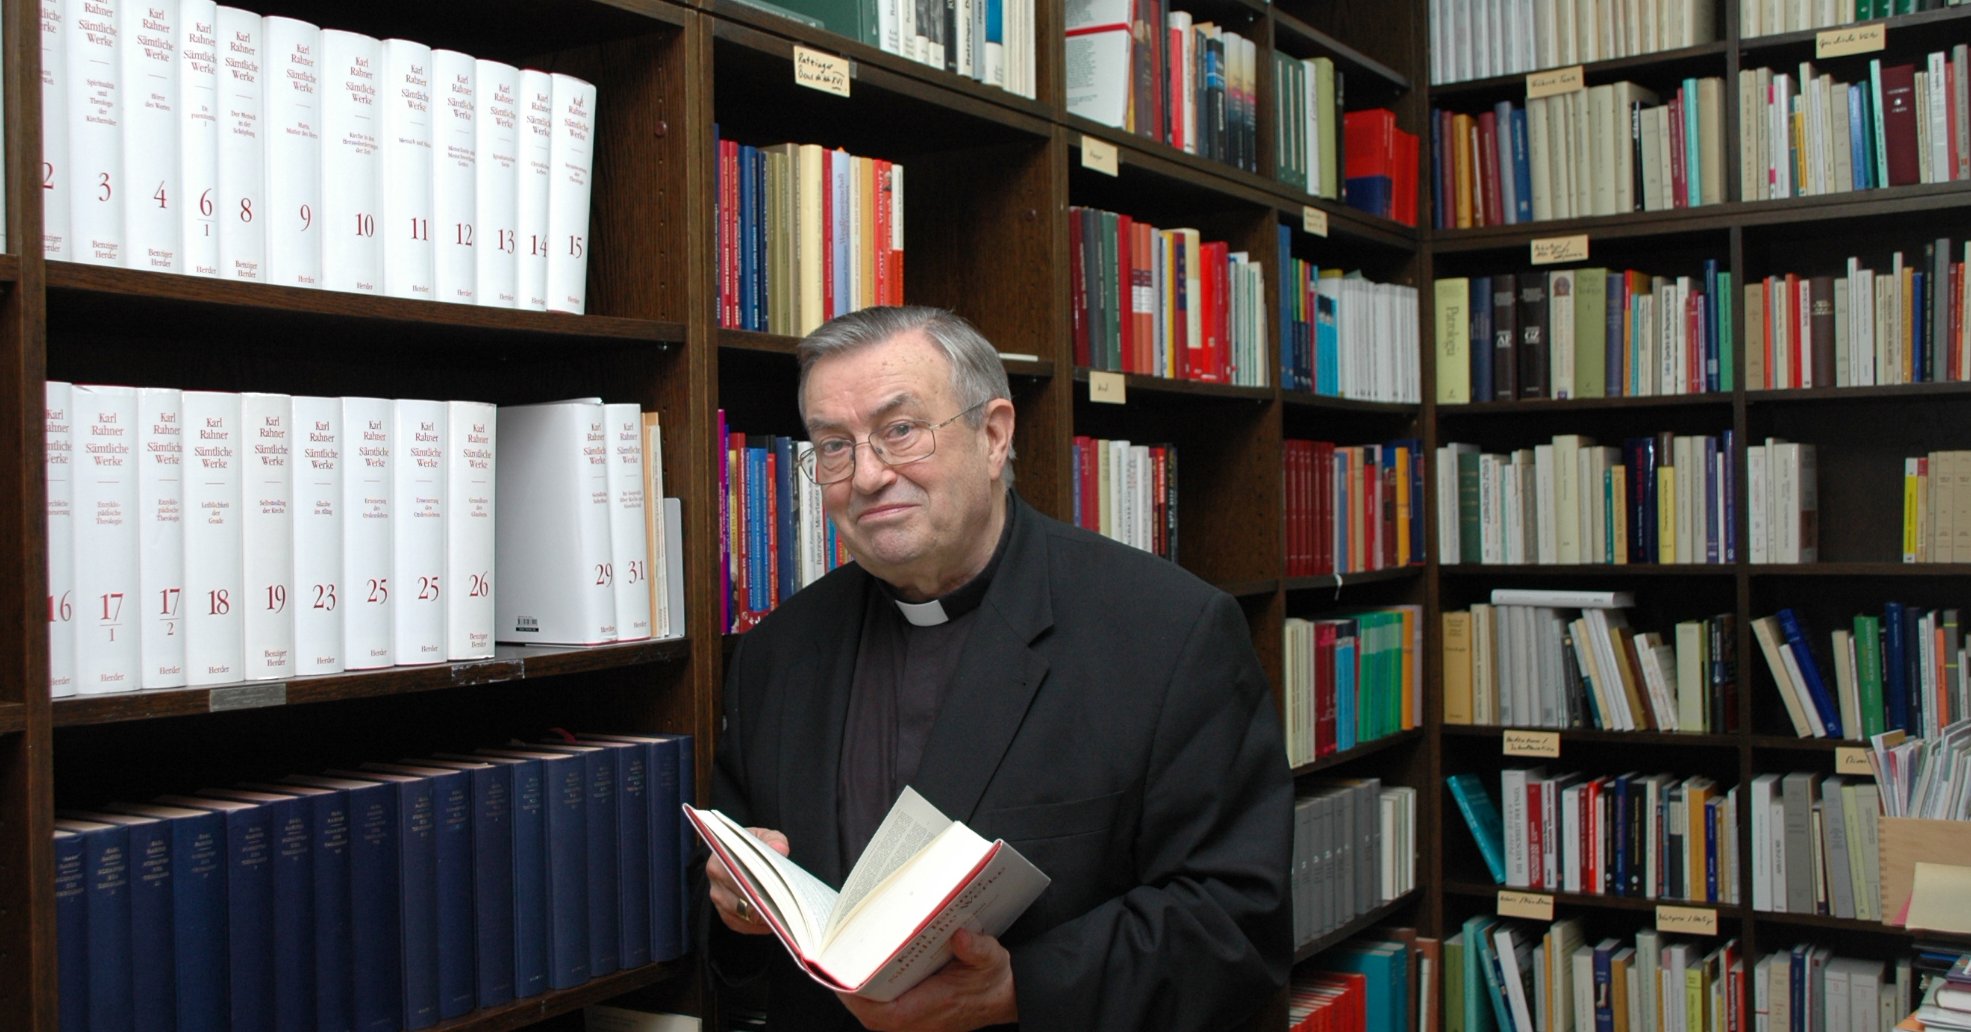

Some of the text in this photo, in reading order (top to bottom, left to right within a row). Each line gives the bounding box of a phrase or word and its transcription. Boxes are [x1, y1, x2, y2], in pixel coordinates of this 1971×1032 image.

[84, 1, 114, 17] Rahner
[147, 9, 164, 21] Karl
[78, 18, 118, 38] Sämtliche
[143, 18, 170, 33] Rahner
[196, 23, 211, 34] Karl
[86, 31, 114, 47] Werke
[137, 35, 175, 52] Sämtliche
[189, 32, 216, 48] Rahner
[235, 32, 250, 43] Karl
[144, 47, 170, 62] Werke
[230, 40, 255, 55] Rahner
[295, 44, 310, 56] Karl
[225, 58, 259, 74] Sämtliche
[291, 52, 314, 67] Rahner
[354, 57, 368, 68] Karl
[191, 60, 216, 76] Werke
[351, 65, 374, 80] Rahner
[232, 68, 256, 83] Werke
[287, 69, 317, 85] Sämtliche
[293, 79, 314, 94] Werke
[346, 82, 376, 97] Sämtliche
[352, 92, 373, 105] Werke
[42, 162, 54, 189] 2
[99, 173, 111, 201] 3
[154, 182, 167, 208] 4
[200, 188, 212, 216] 6
[241, 198, 252, 222] 8
[300, 204, 311, 231] 9
[205, 224, 208, 236] 1
[356, 214, 374, 237] 10
[411, 218, 428, 241] 11
[457, 223, 472, 247] 12
[498, 229, 515, 254] 13
[532, 234, 547, 258] 14
[570, 236, 582, 258] 15
[1446, 305, 1460, 357] Patrologia
[99, 413, 116, 423] Karl
[160, 412, 176, 424] Karl
[206, 417, 222, 427] Karl
[266, 417, 279, 426] Karl
[46, 421, 70, 434] ahner
[92, 425, 124, 436] Rahner
[153, 423, 182, 436] Rahner
[316, 421, 329, 431] Karl
[369, 420, 381, 431] Karl
[421, 422, 434, 433] Karl
[473, 424, 485, 435] Karl
[200, 430, 229, 440] Rahner
[260, 428, 285, 438] Rahner
[310, 432, 335, 442] Rahner
[364, 431, 386, 441] Rahner
[416, 432, 439, 442] Rahner
[468, 432, 488, 444] Rahner
[86, 443, 129, 453] Sämtliche
[195, 447, 232, 457] Sämtliche
[255, 443, 289, 456] Sämtliche
[305, 448, 339, 459] Sämtliche
[359, 447, 389, 458] Sämtliche
[411, 446, 442, 459] Sämtliche
[463, 449, 491, 460] Sämtliche
[93, 456, 123, 466] Werke
[155, 453, 181, 466] Werke
[202, 459, 227, 468] Werke
[261, 456, 284, 466] Werke
[312, 460, 334, 469] Werke
[365, 458, 386, 468] Werke
[417, 459, 439, 468] Werke
[469, 460, 488, 469] Werke
[595, 563, 614, 587] 29
[629, 561, 646, 584] 31
[367, 579, 387, 604] 25
[418, 577, 439, 601] 25
[470, 572, 488, 597] 26
[160, 588, 180, 614] 17
[208, 590, 229, 615] 18
[267, 585, 286, 613] 19
[313, 584, 336, 611] 23
[46, 588, 72, 622] 16
[101, 593, 123, 620] 17
[110, 628, 114, 642] 1
[167, 622, 174, 635] 2
[897, 934, 927, 964] Karl
